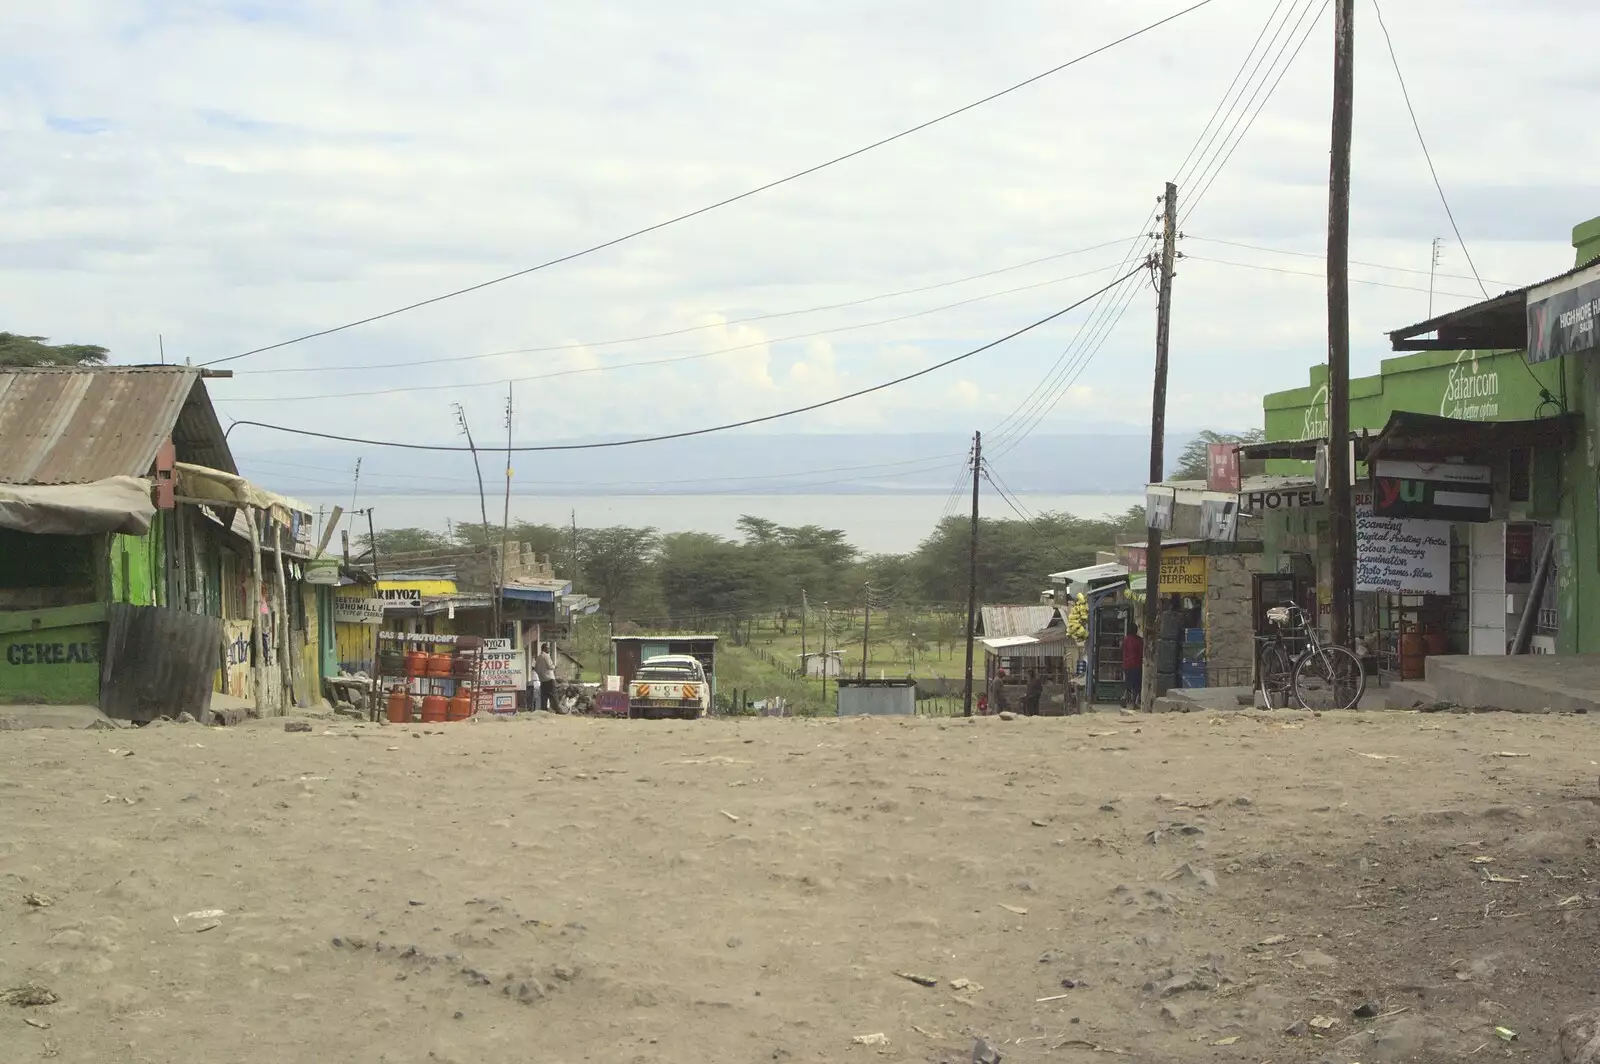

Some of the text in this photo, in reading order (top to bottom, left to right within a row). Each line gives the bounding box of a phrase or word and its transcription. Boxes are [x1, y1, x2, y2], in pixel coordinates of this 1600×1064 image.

[1559, 310, 1577, 329] HIGH
[1447, 367, 1499, 402] Safaricom
[1454, 402, 1499, 422] the better option
[1355, 494, 1372, 506] BLE
[1380, 478, 1425, 509] yu
[1248, 491, 1325, 511] HOTEL
[1358, 519, 1403, 534] Scanning
[1357, 531, 1389, 544] Digital
[1358, 543, 1426, 559] Colour Photocopy
[1359, 553, 1408, 567] Lamination
[1160, 565, 1186, 574] STAR
[1358, 564, 1381, 575] Photo
[377, 589, 421, 600] KINYOZI
[379, 631, 459, 643] GAS & PHOTOCOPY
